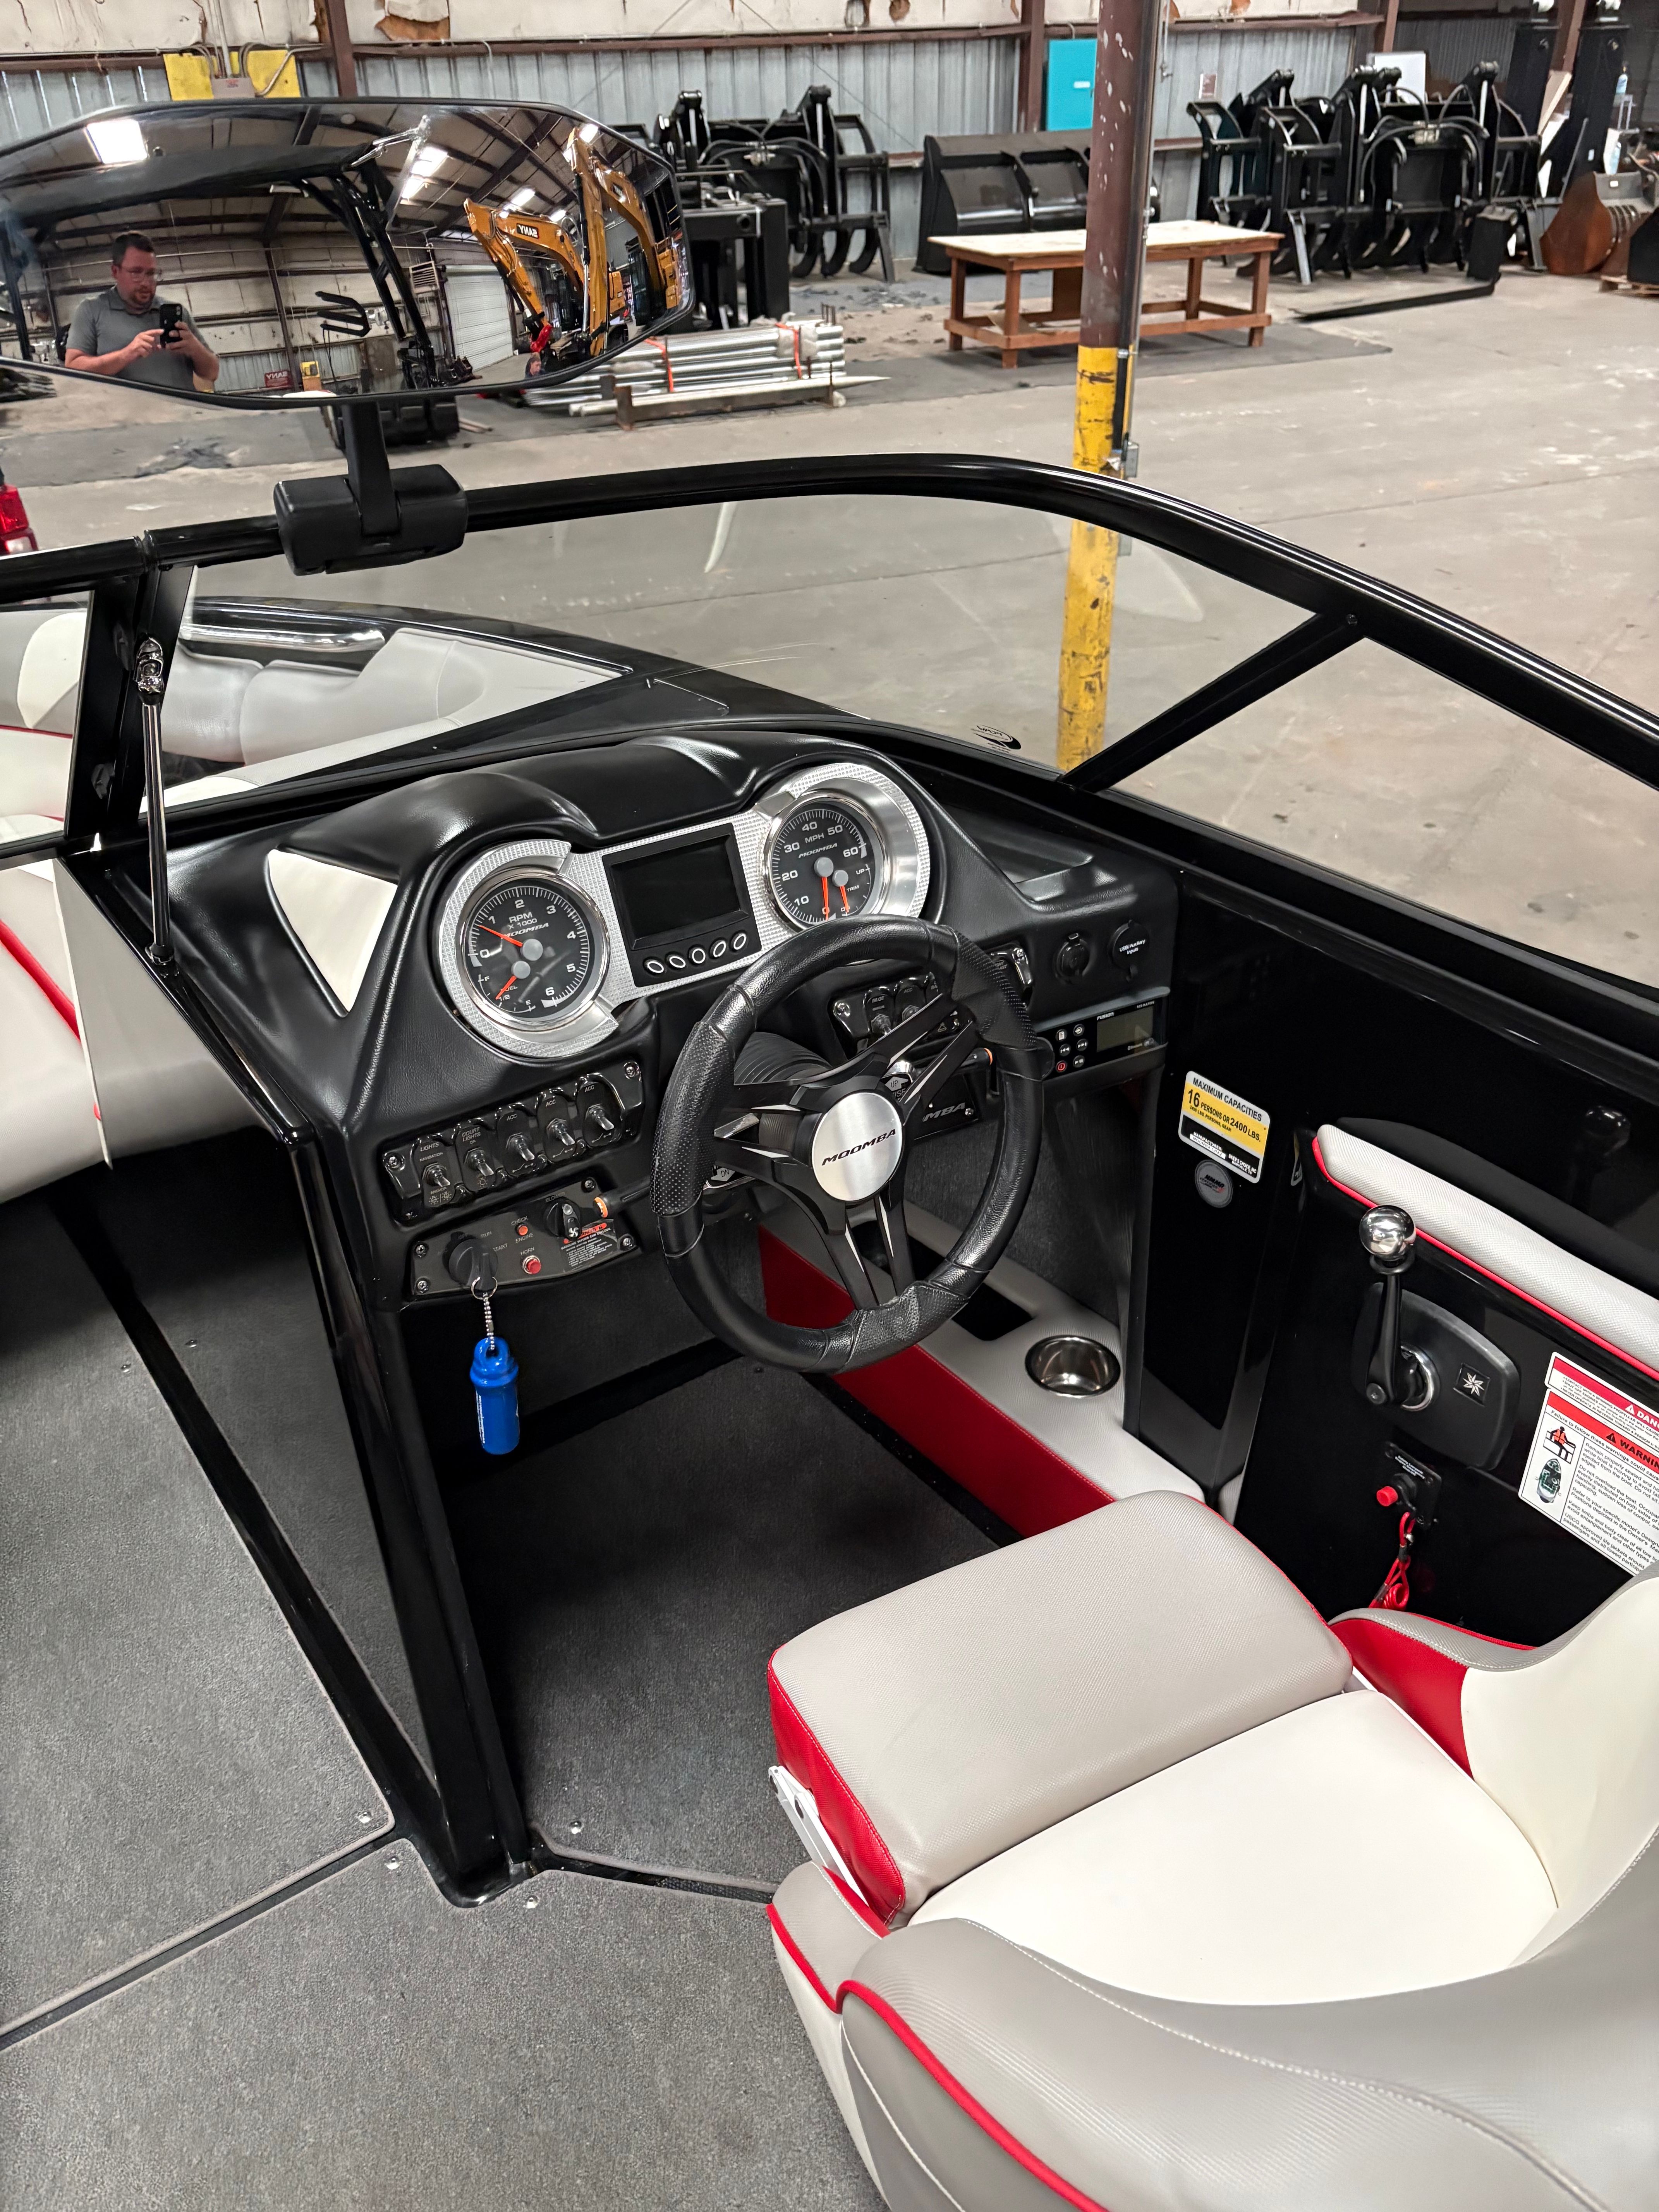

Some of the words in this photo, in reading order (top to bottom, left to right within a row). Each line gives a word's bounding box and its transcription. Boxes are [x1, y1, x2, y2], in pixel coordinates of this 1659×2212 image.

[802, 822, 817, 831] 40
[827, 825, 843, 836] 50
[805, 833, 824, 844] MPH
[784, 842, 800, 853] 30
[798, 843, 838, 858] MOOMBA
[843, 847, 858, 857] 60
[781, 870, 798, 881] 20
[515, 899, 525, 908] 2
[794, 896, 809, 906] 10
[546, 905, 556, 914] 3
[488, 915, 496, 924] 1
[509, 912, 533, 923] RPM
[517, 918, 537, 928] 1000
[567, 931, 576, 939] 4
[479, 949, 489, 958] 0
[567, 963, 576, 972] 5
[545, 987, 555, 996] 6
[1193, 1078, 1223, 1100] MAXIMUM
[1224, 1095, 1262, 1121] CAPACITIES
[922, 1102, 965, 1122] MBA
[1188, 1089, 1200, 1108] 16
[1200, 1102, 1222, 1119] PERSONS
[1223, 1115, 1230, 1123] OR
[1230, 1118, 1247, 1133] 2400
[1248, 1129, 1261, 1142] LBS.
[462, 1127, 480, 1137] COURT
[463, 1132, 481, 1142] LIGHTS
[420, 1142, 439, 1152] LIGHTS
[821, 1129, 896, 1166] MOOMBA
[419, 1152, 443, 1162] NAVIGATION
[511, 1216, 528, 1226] CHECK
[515, 1233, 534, 1243] ENGINE
[520, 1247, 534, 1255] HORN
[1551, 1410, 1567, 1422] Failure
[1575, 1425, 1590, 1436] follow
[1591, 1436, 1604, 1446] these
[1606, 1445, 1629, 1462] warnings
[1631, 1461, 1645, 1472] could
[1586, 1443, 1603, 1456] Remain
[1604, 1456, 1624, 1470] properly
[1625, 1468, 1642, 1480] seated
[1583, 1453, 1599, 1465] ejected
[1601, 1464, 1611, 1473] from
[1621, 1477, 1632, 1487] boat.
[1585, 1448, 1596, 1457] while
[1597, 1456, 1607, 1465] boat
[1614, 1467, 1631, 1480] moving
[1638, 1483, 1652, 1493] avoid
[1575, 1479, 1597, 1496] capsizing.
[1595, 1476, 1616, 1491] overload
[1578, 1470, 1593, 1481] evenly
[1594, 1480, 1618, 1498] distributed
[1626, 1501, 1637, 1510] both
[1573, 1487, 1585, 1497] Refer
[1592, 1500, 1602, 1509] your
[1603, 1508, 1620, 1522] specific
[1598, 1489, 1616, 1502] sudden
[1616, 1500, 1626, 1509] loss
[1571, 1492, 1592, 1508] Positions
[1593, 1507, 1613, 1522] depicted
[1568, 1506, 1580, 1515] avoid
[1580, 1515, 1612, 1537] entanglement
[1623, 1543, 1635, 1552] other
[1636, 1551, 1649, 1562] types
[1569, 1500, 1580, 1510] Keep
[1582, 1509, 1594, 1519] limbs
[1605, 1524, 1616, 1534] body
[1617, 1534, 1629, 1542] clear
[1643, 1550, 1651, 1558] tow
[1563, 1518, 1589, 1537] passengers
[1607, 1547, 1621, 1558] towed
[1581, 1524, 1602, 1540] approved
[1611, 1544, 1627, 1558] jackets
[1628, 1557, 1644, 1569] should
